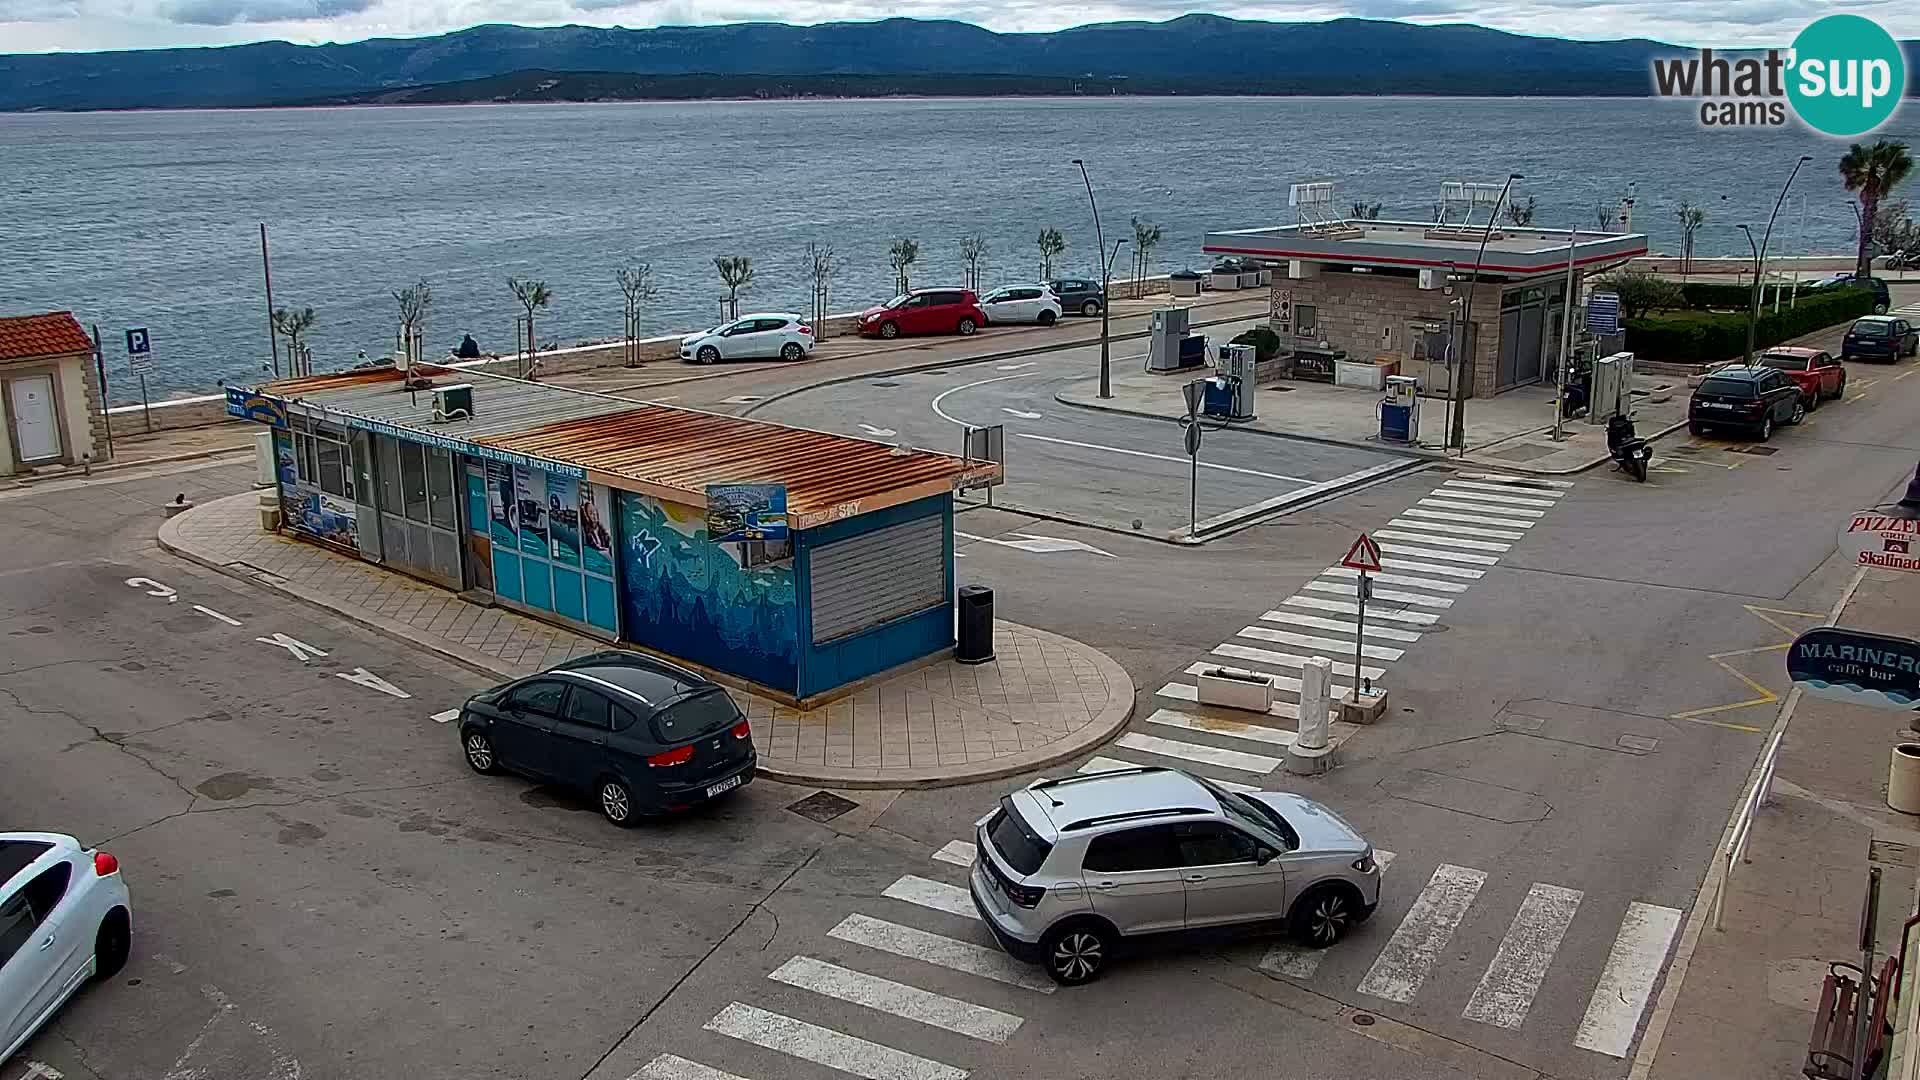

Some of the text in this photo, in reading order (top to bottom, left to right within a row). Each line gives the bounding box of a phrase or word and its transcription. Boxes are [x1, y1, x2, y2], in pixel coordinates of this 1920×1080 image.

[131, 331, 144, 351] P
[437, 437, 468, 454] POSTAJA
[479, 447, 493, 458] BUS
[495, 450, 527, 465] STATION
[528, 457, 554, 472] TICKET
[556, 463, 583, 478] OFFICE
[1828, 663, 1896, 681] caffe bar
